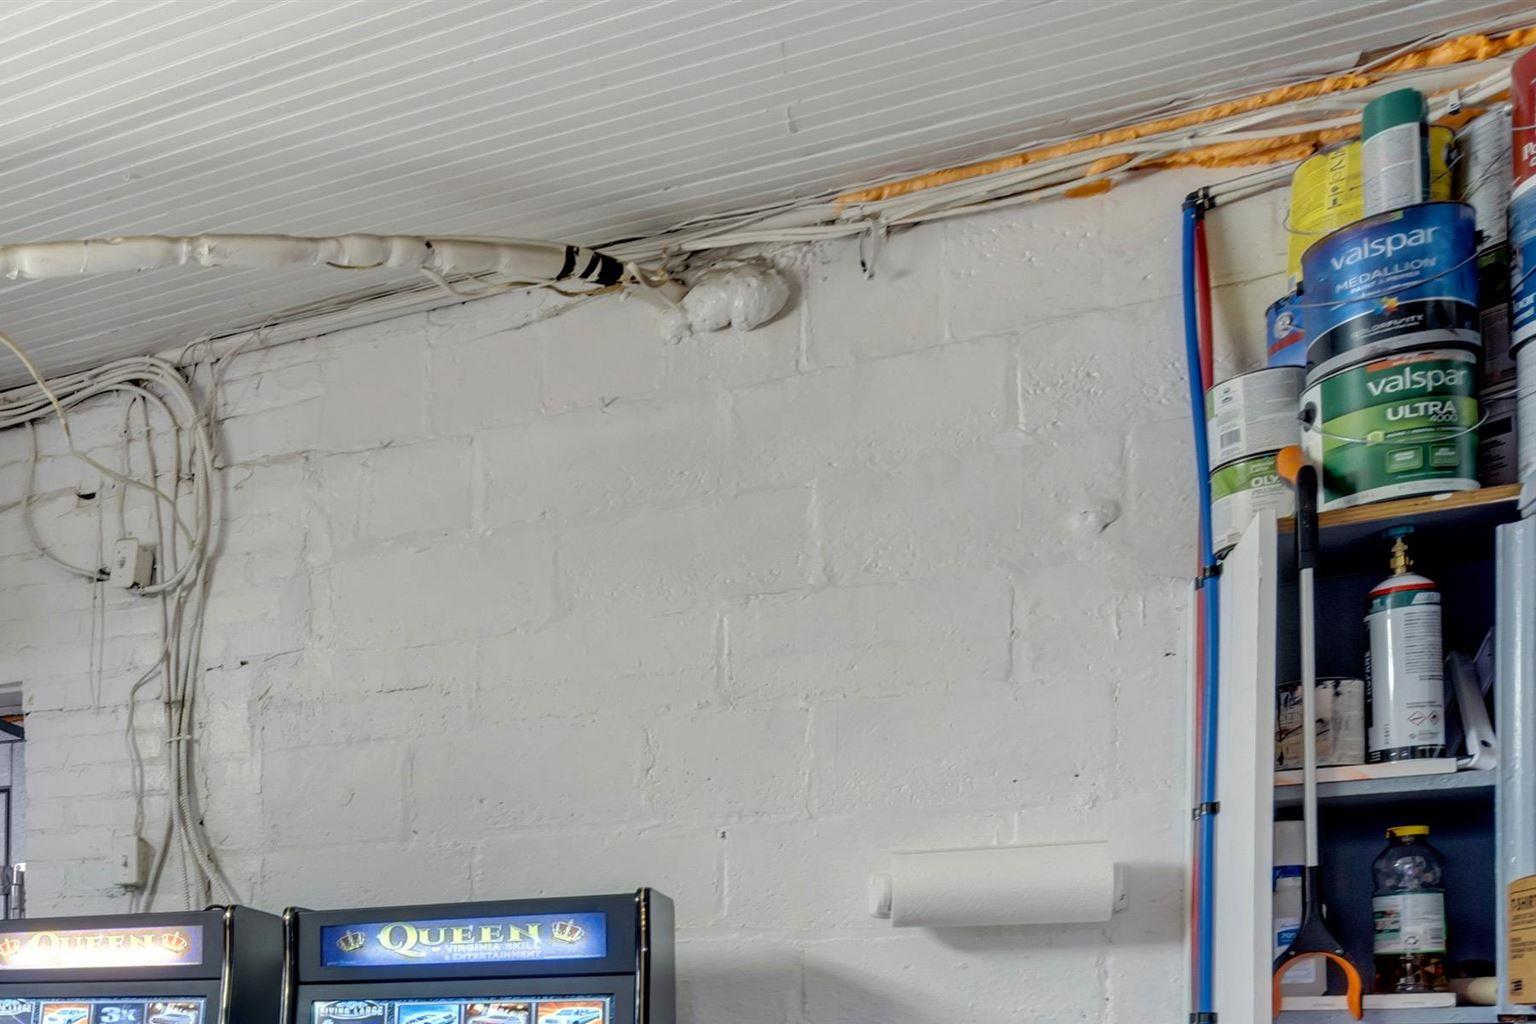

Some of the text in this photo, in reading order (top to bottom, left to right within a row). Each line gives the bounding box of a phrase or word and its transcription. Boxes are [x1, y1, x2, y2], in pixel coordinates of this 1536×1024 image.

[1330, 226, 1440, 271] valspar
[1335, 257, 1437, 293] MEDALLION
[1367, 366, 1466, 397] valspar
[1386, 400, 1456, 421] ULTRA
[377, 921, 543, 958] QUEEN
